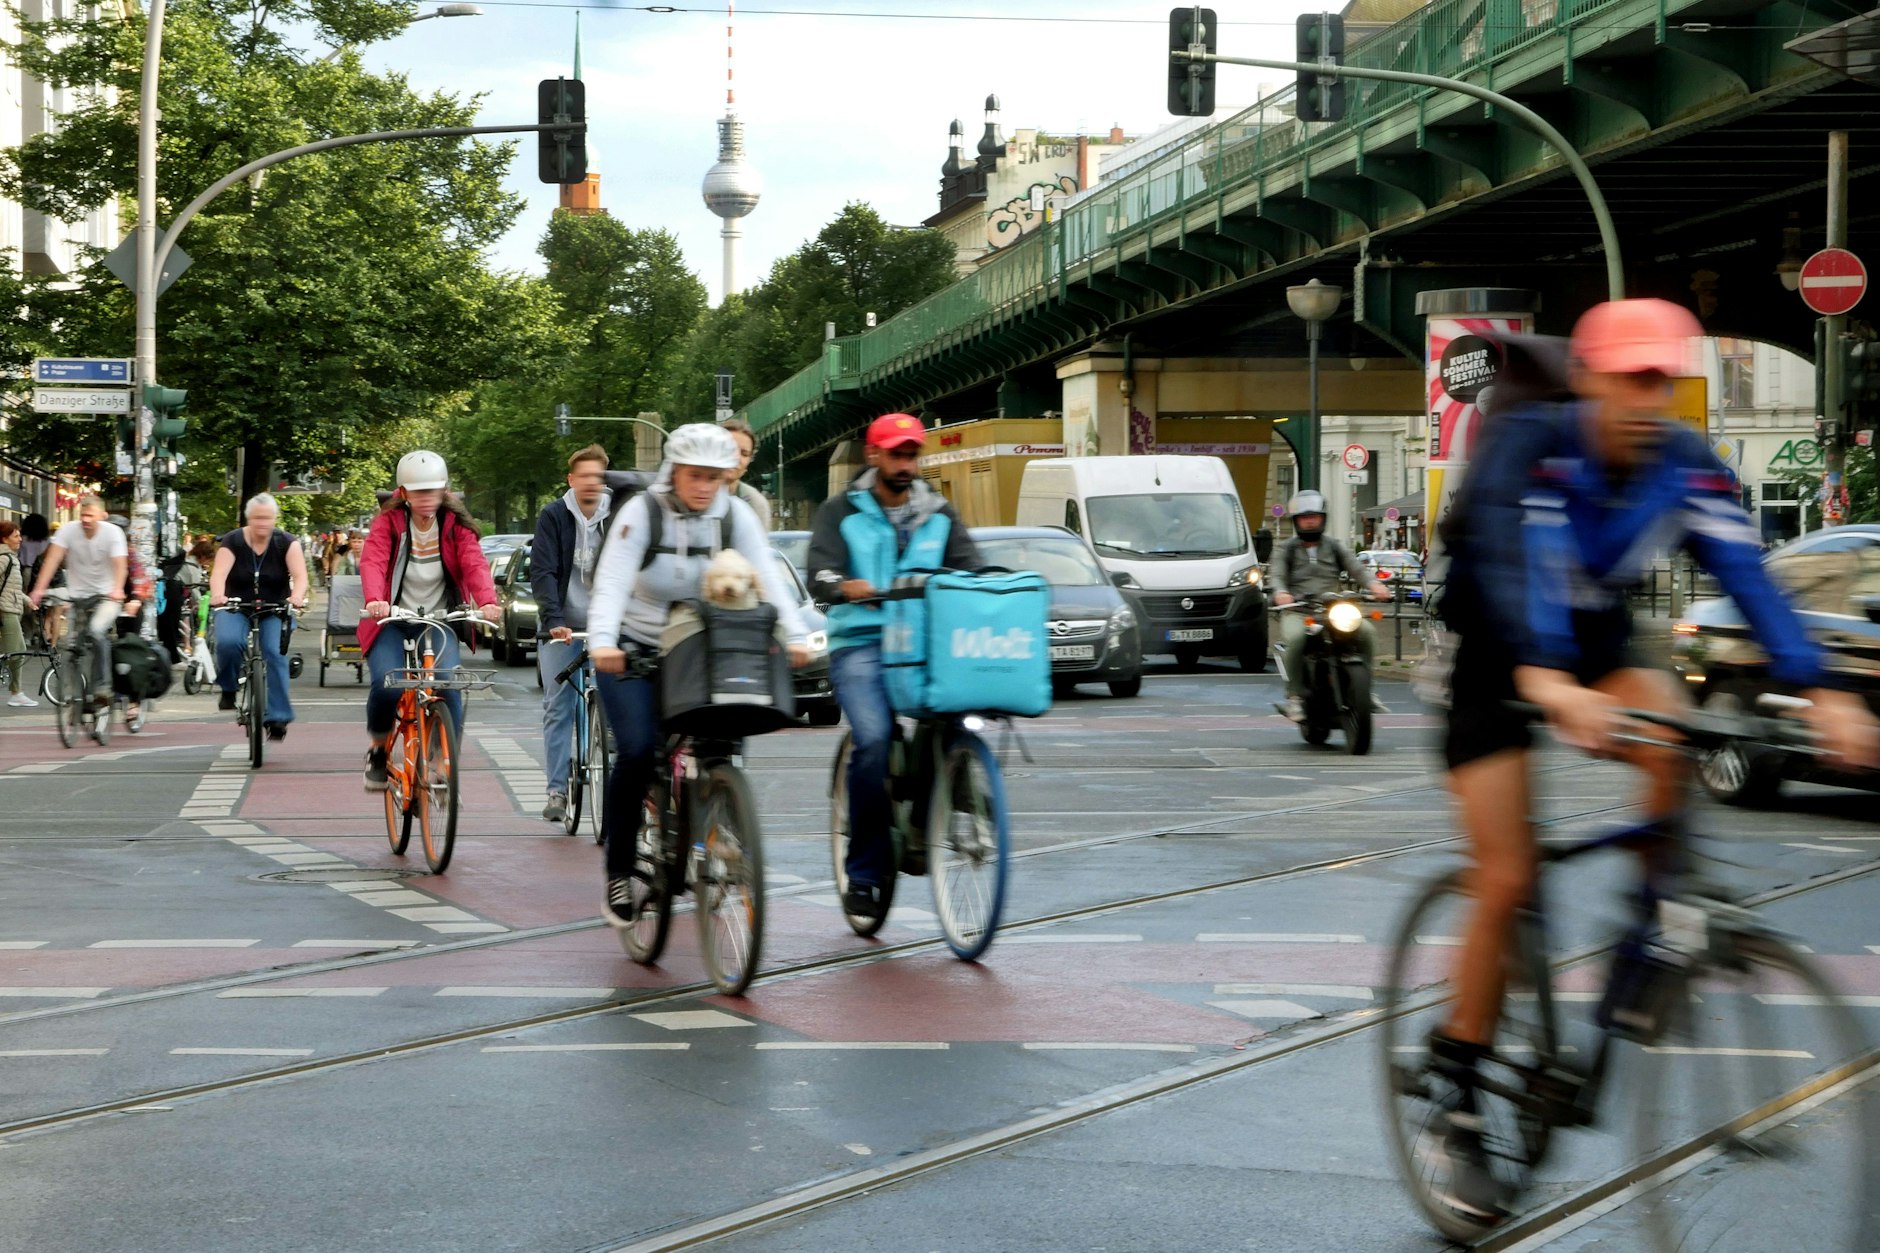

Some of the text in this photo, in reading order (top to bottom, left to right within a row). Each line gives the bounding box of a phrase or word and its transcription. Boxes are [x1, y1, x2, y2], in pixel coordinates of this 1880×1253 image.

[1449, 349, 1488, 367] KULTUR
[1443, 358, 1486, 378] SOMMER
[1450, 364, 1497, 384] FESTIVAL
[40, 393, 125, 409] Danziger Straße
